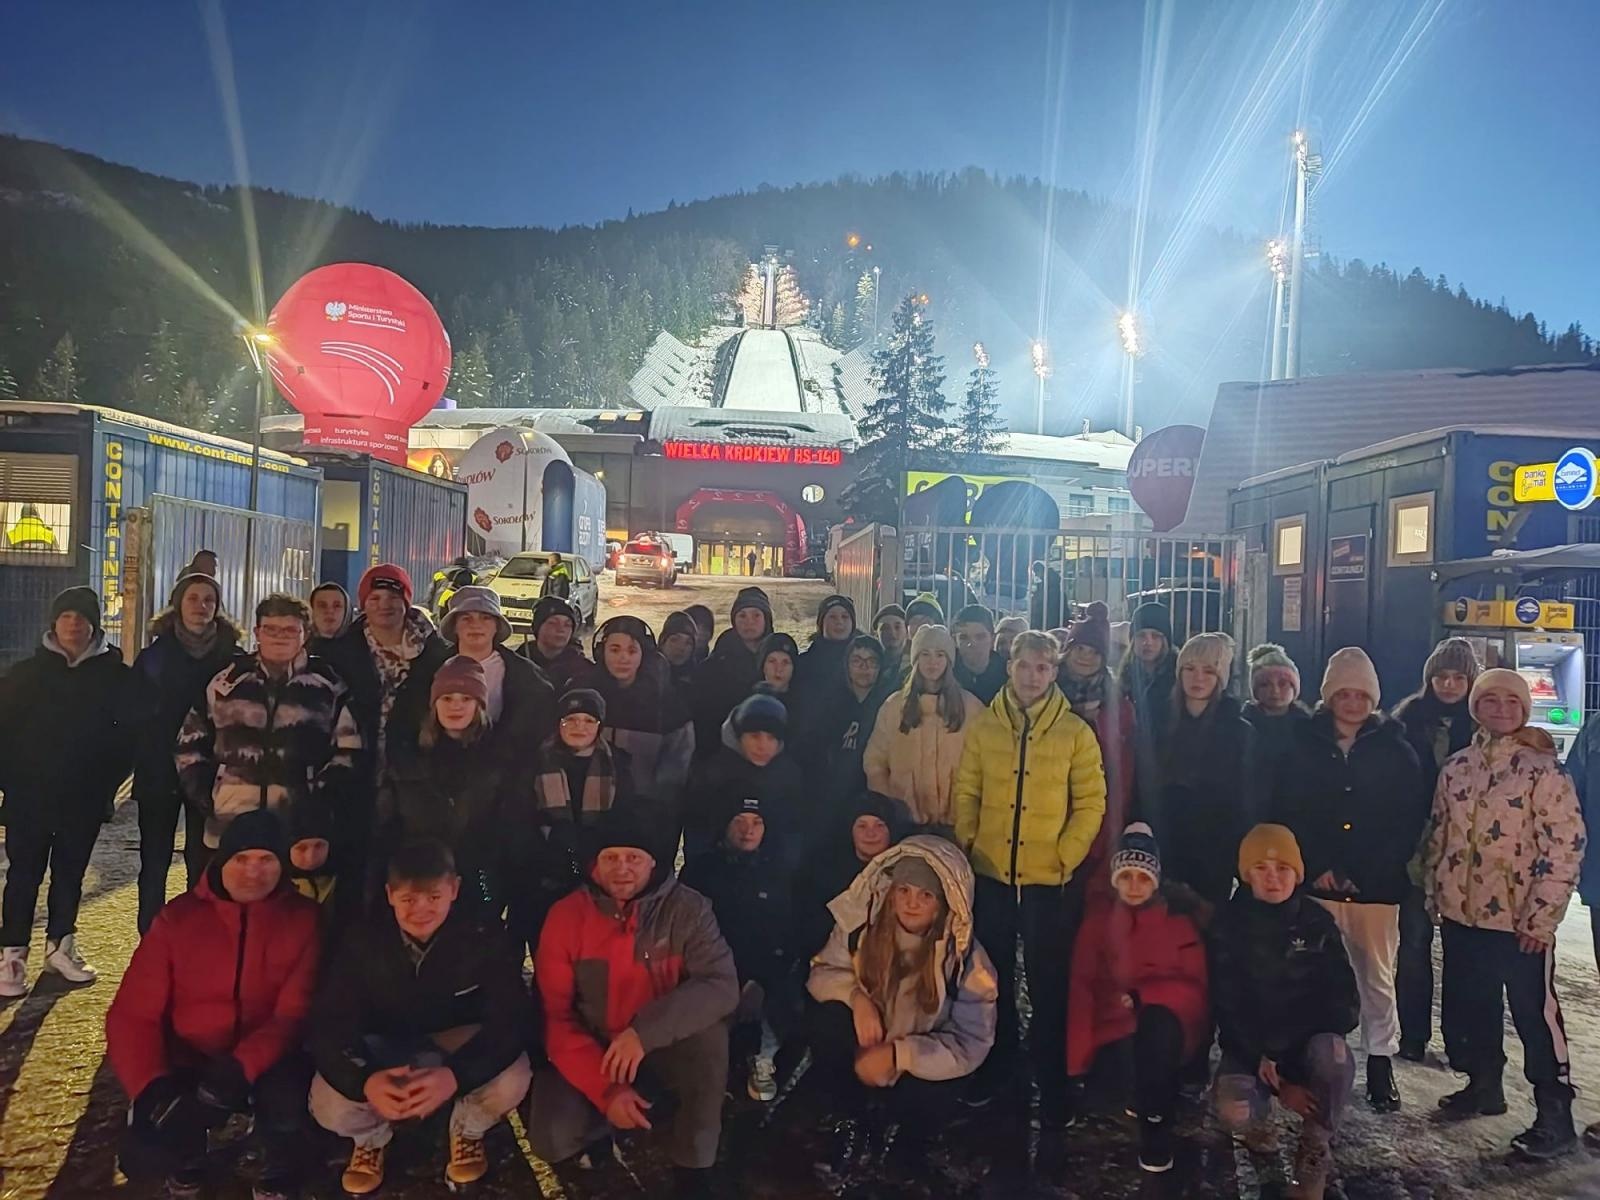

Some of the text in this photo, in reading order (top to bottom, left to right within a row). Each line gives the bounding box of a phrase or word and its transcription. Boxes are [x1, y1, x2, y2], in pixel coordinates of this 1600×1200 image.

[347, 311, 372, 321] Sportu
[147, 432, 290, 474] www.containe.com
[664, 442, 842, 466] WIELKA KROKIEW HS-140
[1127, 457, 1200, 478] UPER
